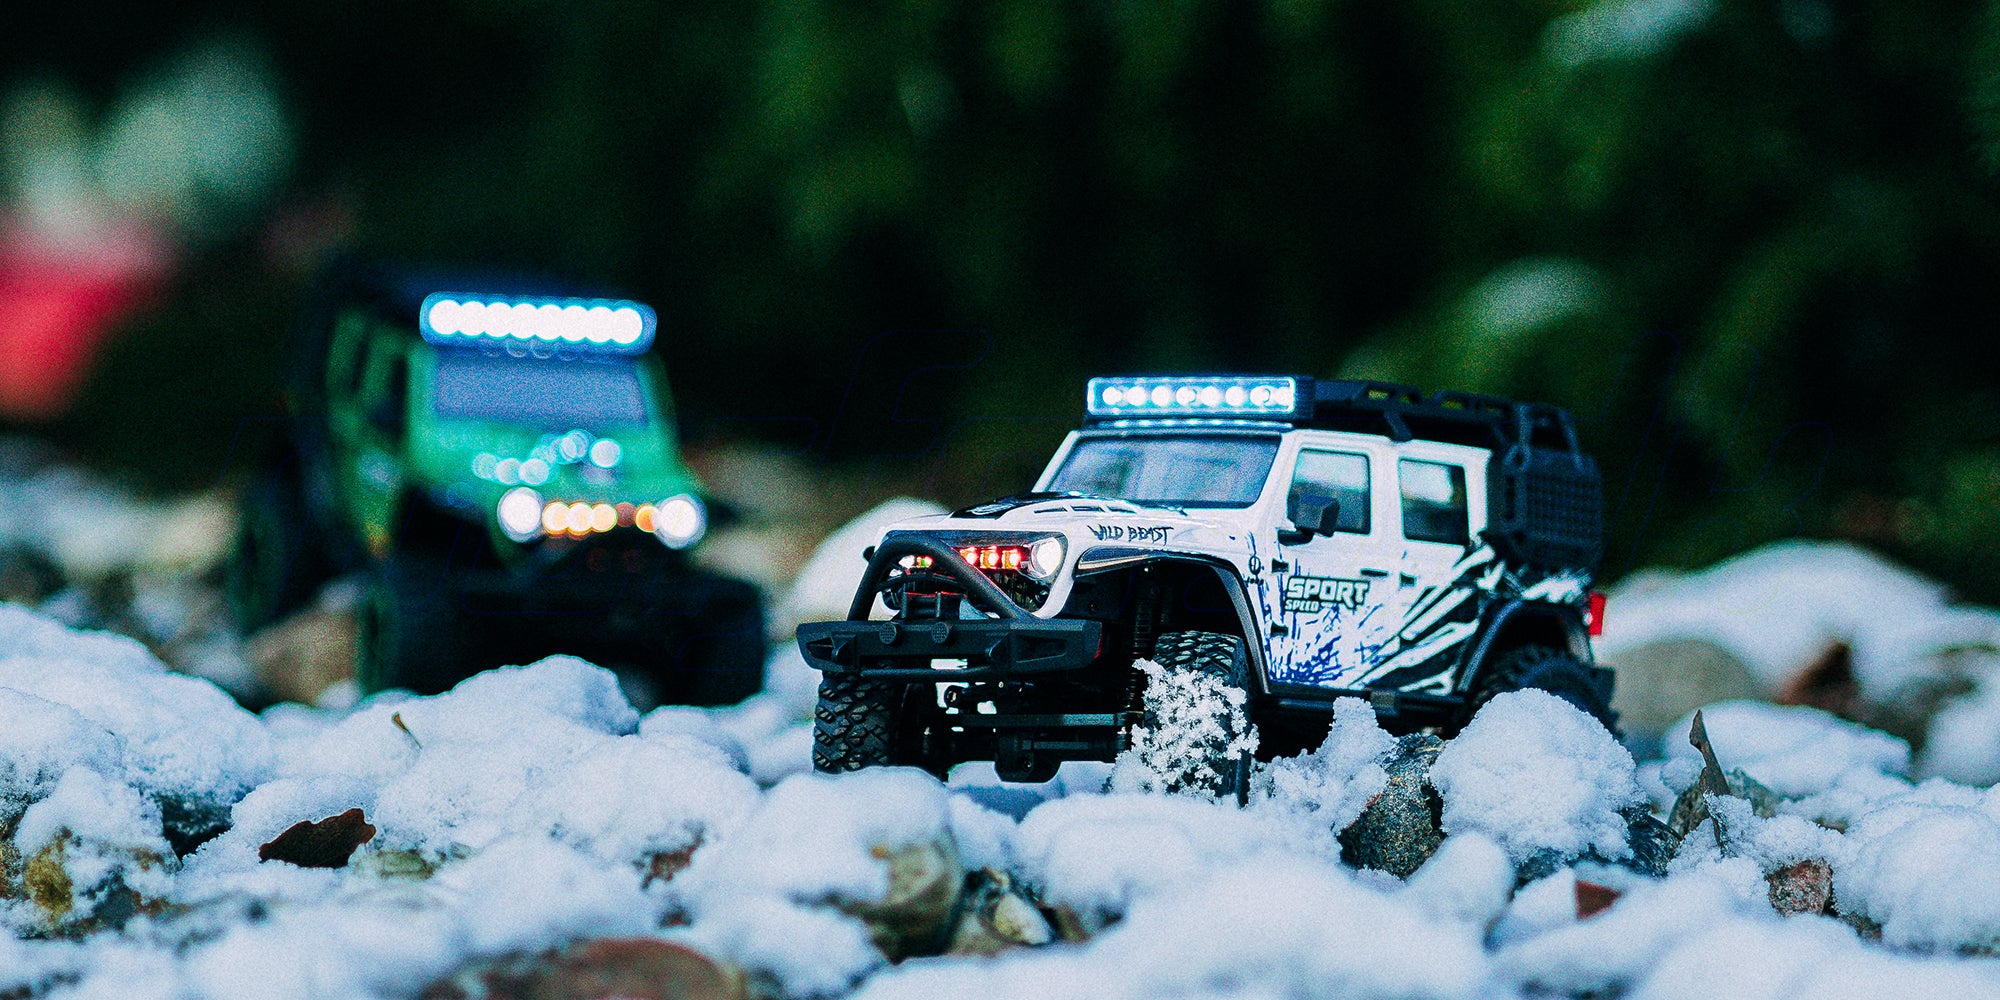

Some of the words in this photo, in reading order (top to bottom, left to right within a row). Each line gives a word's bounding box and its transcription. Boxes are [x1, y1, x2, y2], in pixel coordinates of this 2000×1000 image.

[1087, 524, 1124, 541] WILD
[1127, 525, 1174, 546] BEAST
[1286, 577, 1369, 609] SPORT
[1284, 599, 1320, 612] SPEED
